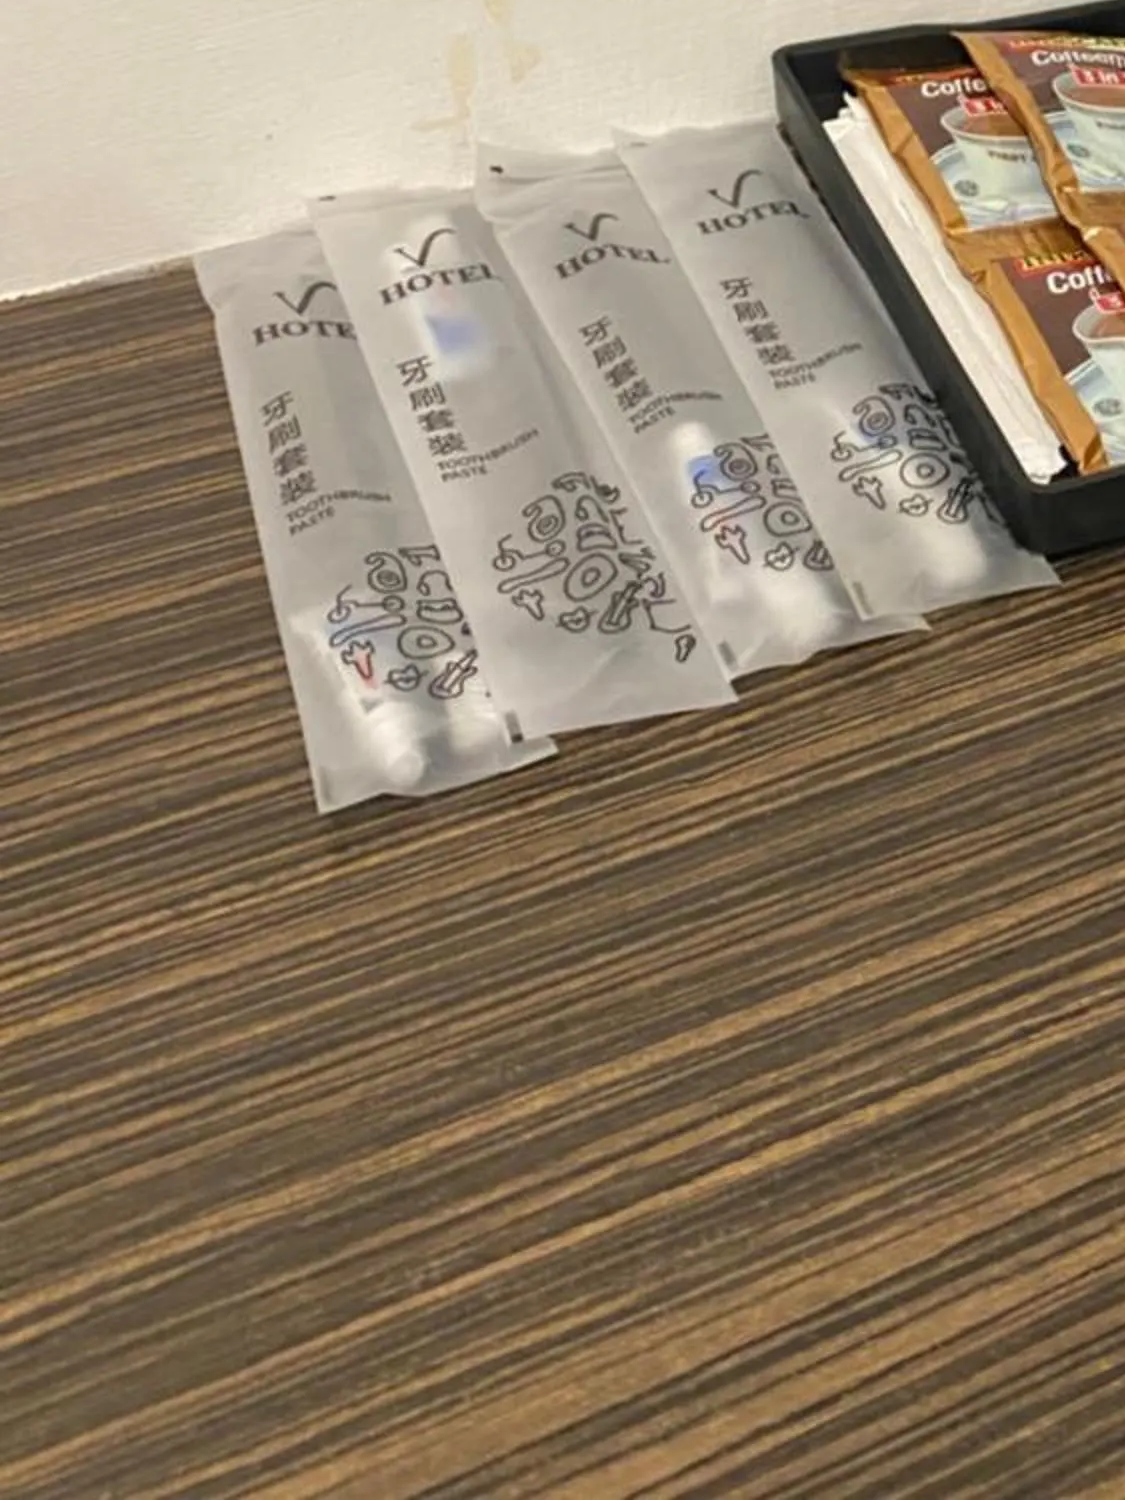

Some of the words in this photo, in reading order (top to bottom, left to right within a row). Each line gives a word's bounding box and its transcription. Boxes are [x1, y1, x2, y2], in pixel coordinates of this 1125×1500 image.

[697, 201, 811, 235] HOTEL
[554, 243, 672, 279] HOTEL
[379, 262, 504, 306] HOTEL
[252, 320, 358, 347] HOTE
